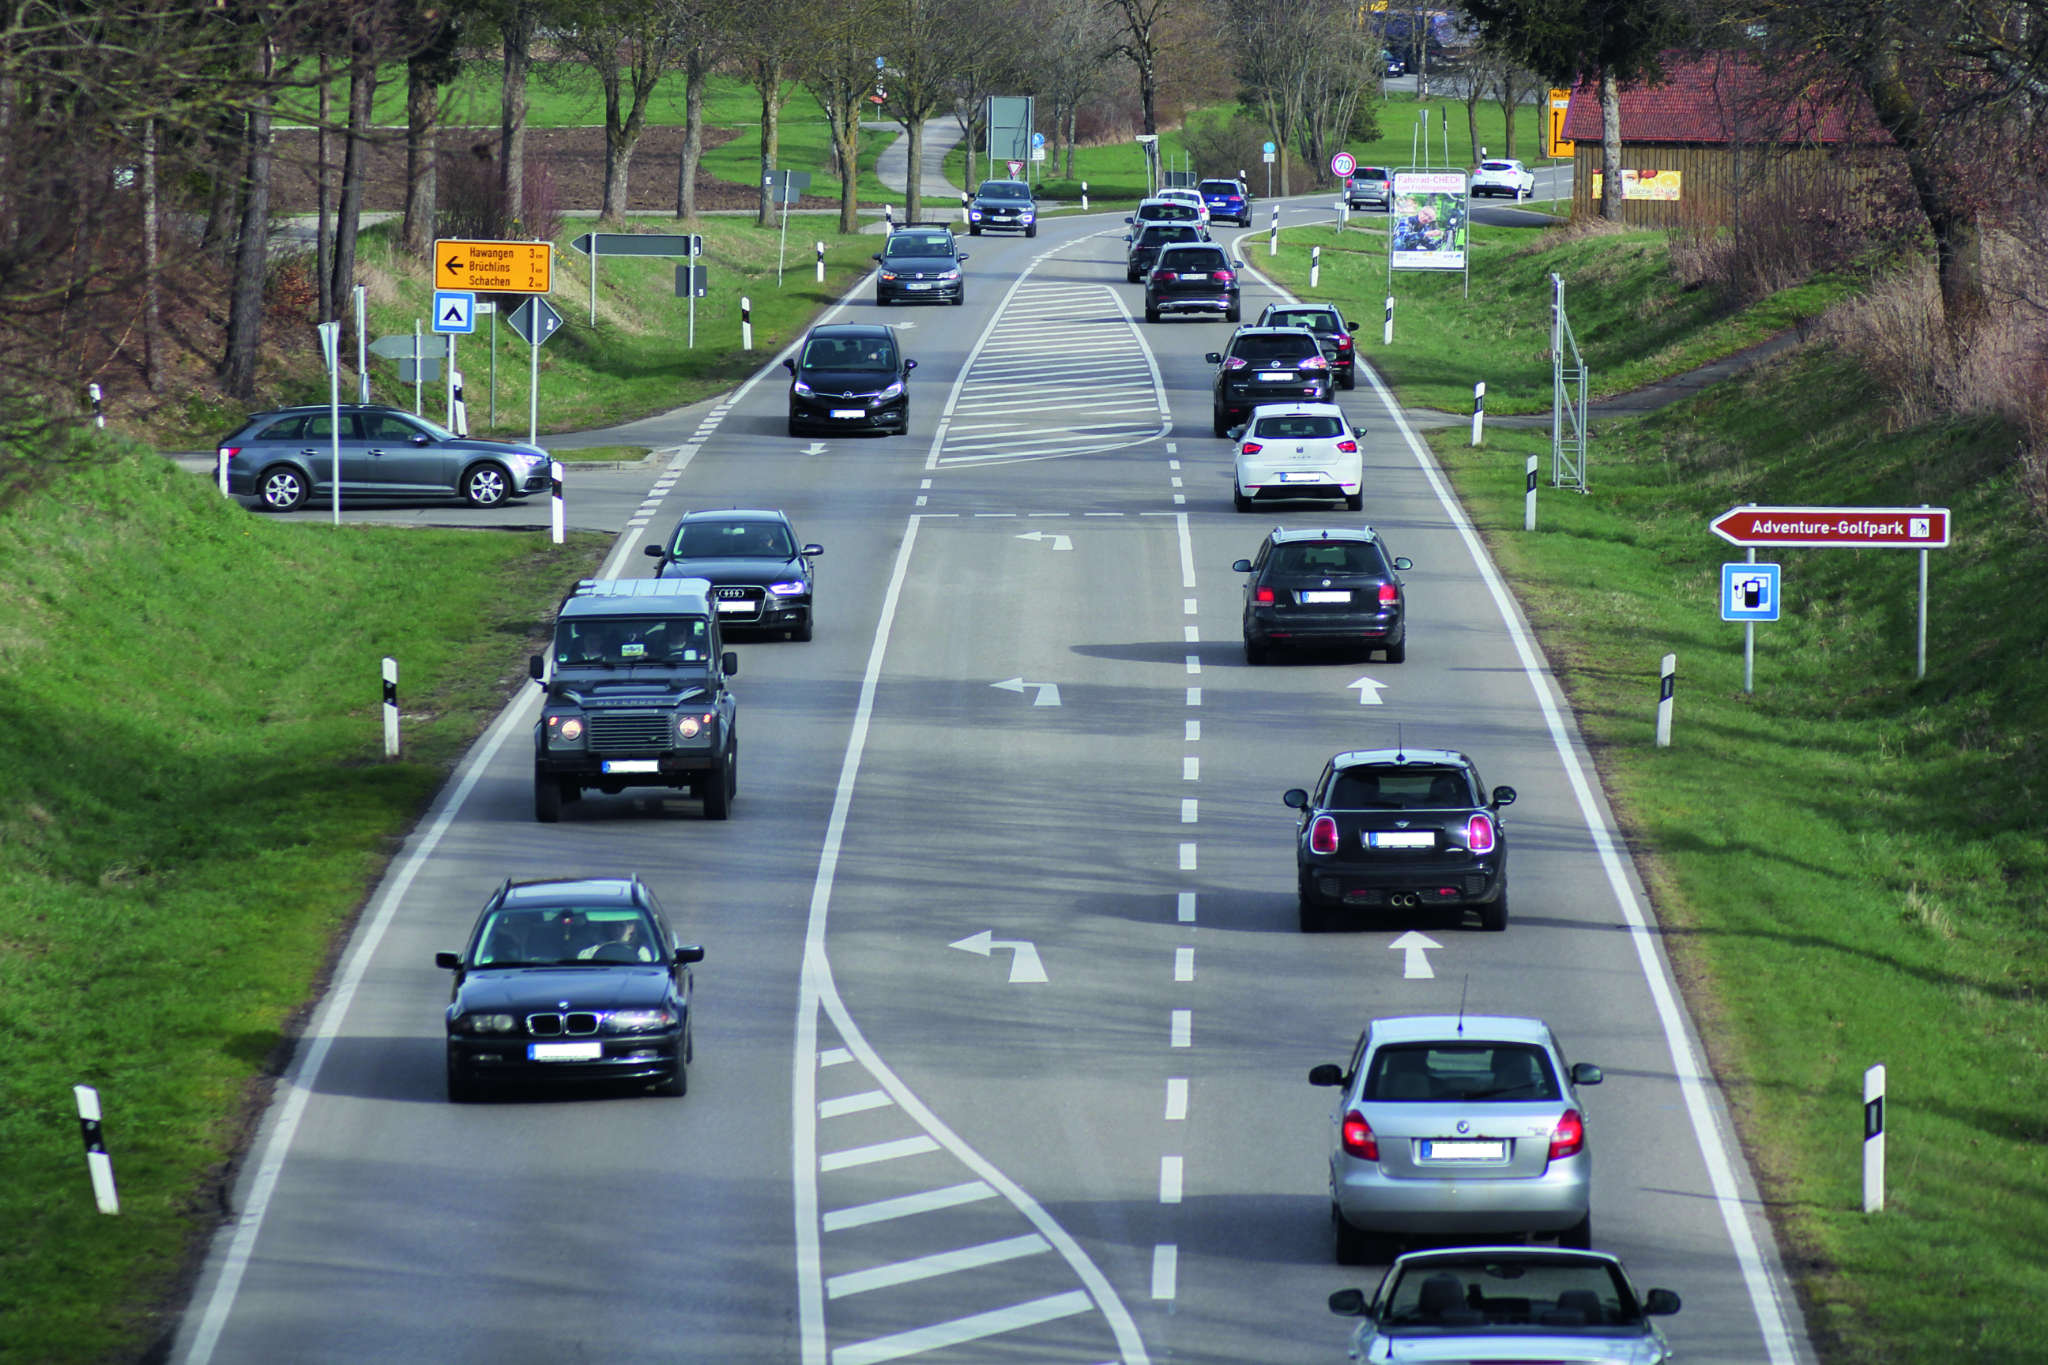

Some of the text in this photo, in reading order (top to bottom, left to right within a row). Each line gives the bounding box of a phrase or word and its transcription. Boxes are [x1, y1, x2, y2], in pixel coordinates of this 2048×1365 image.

[1337, 159, 1351, 171] 70
[1397, 175, 1461, 184] Fahrrad-CHECK
[469, 247, 514, 260] Hawangen
[529, 248, 535, 259] 3
[469, 261, 511, 273] Brüchlins
[530, 262, 535, 273] 1
[469, 275, 511, 287] Schachen
[528, 276, 534, 287] 2
[1751, 519, 1904, 538] Adventure-Golfpark
